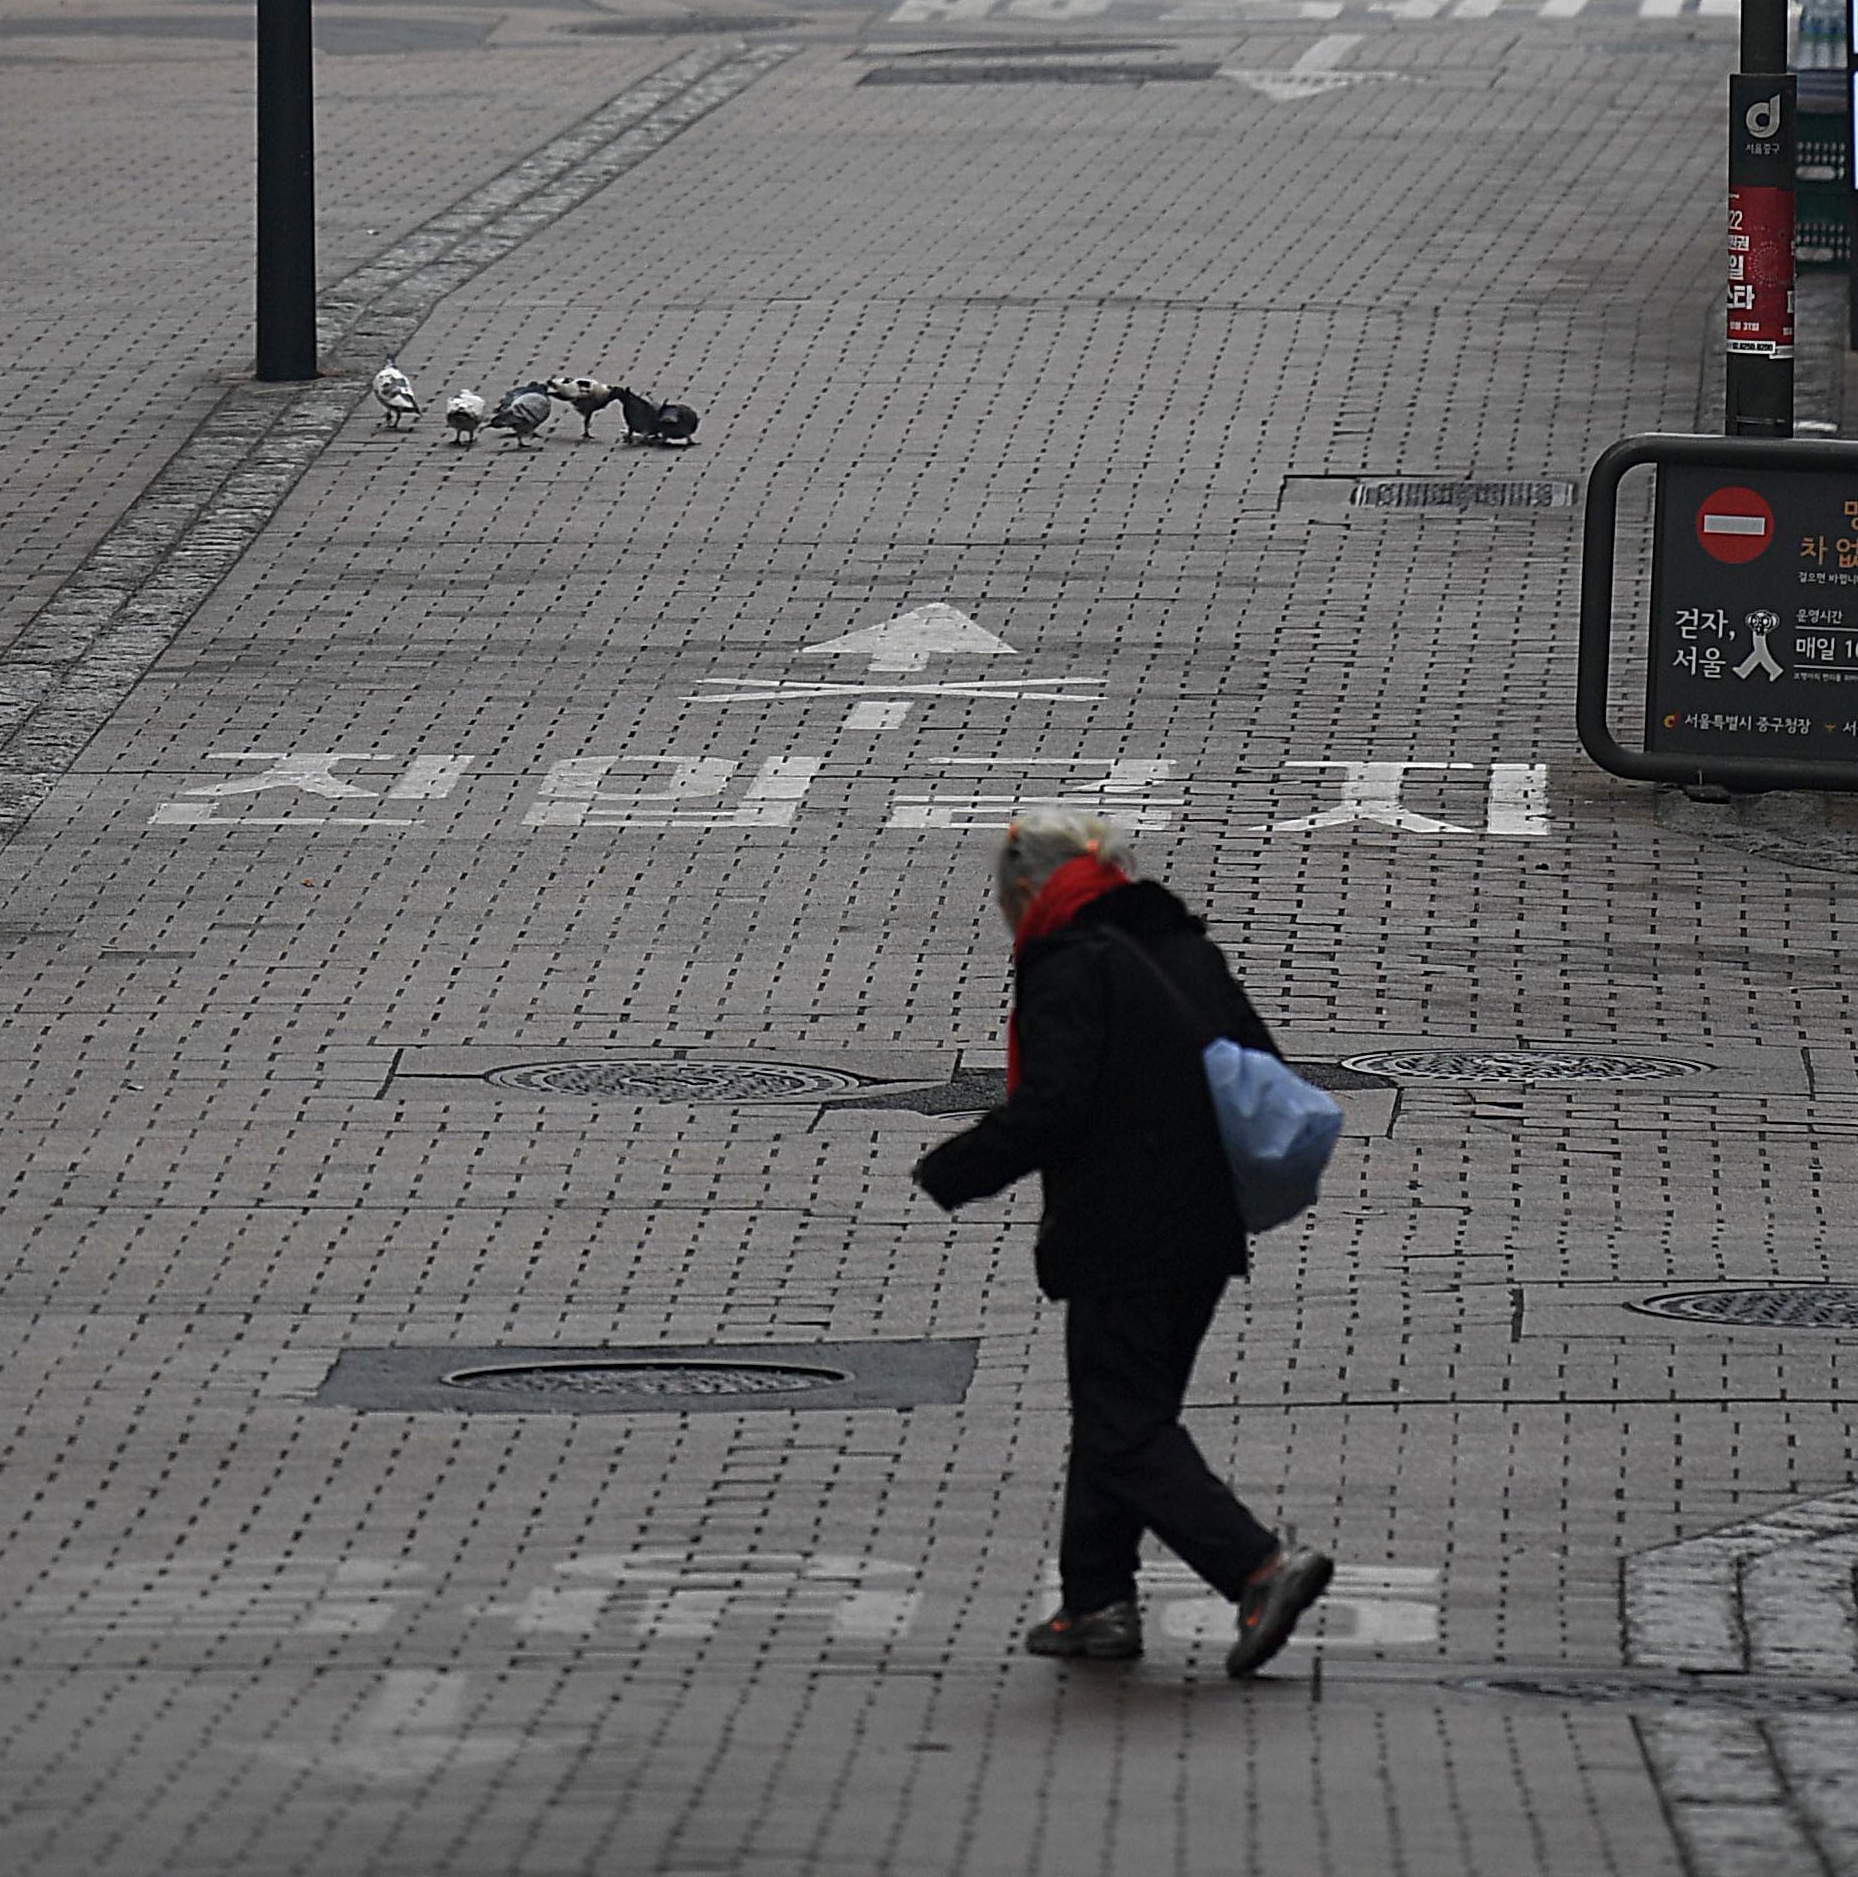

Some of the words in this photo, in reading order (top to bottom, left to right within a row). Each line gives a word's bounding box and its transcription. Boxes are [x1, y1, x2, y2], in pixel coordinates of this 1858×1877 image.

[1745, 142, 1782, 156] 서울중구
[1800, 534, 1828, 566] 차
[1675, 608, 1736, 642] 걷자,
[1795, 608, 1844, 625] 운영시간
[1672, 645, 1727, 680] 서울
[1795, 636, 1836, 662] 매일
[1684, 711, 1753, 731] 서울특별시
[1758, 713, 1812, 736] 중구청장
[146, 751, 1552, 837] 진입금지
